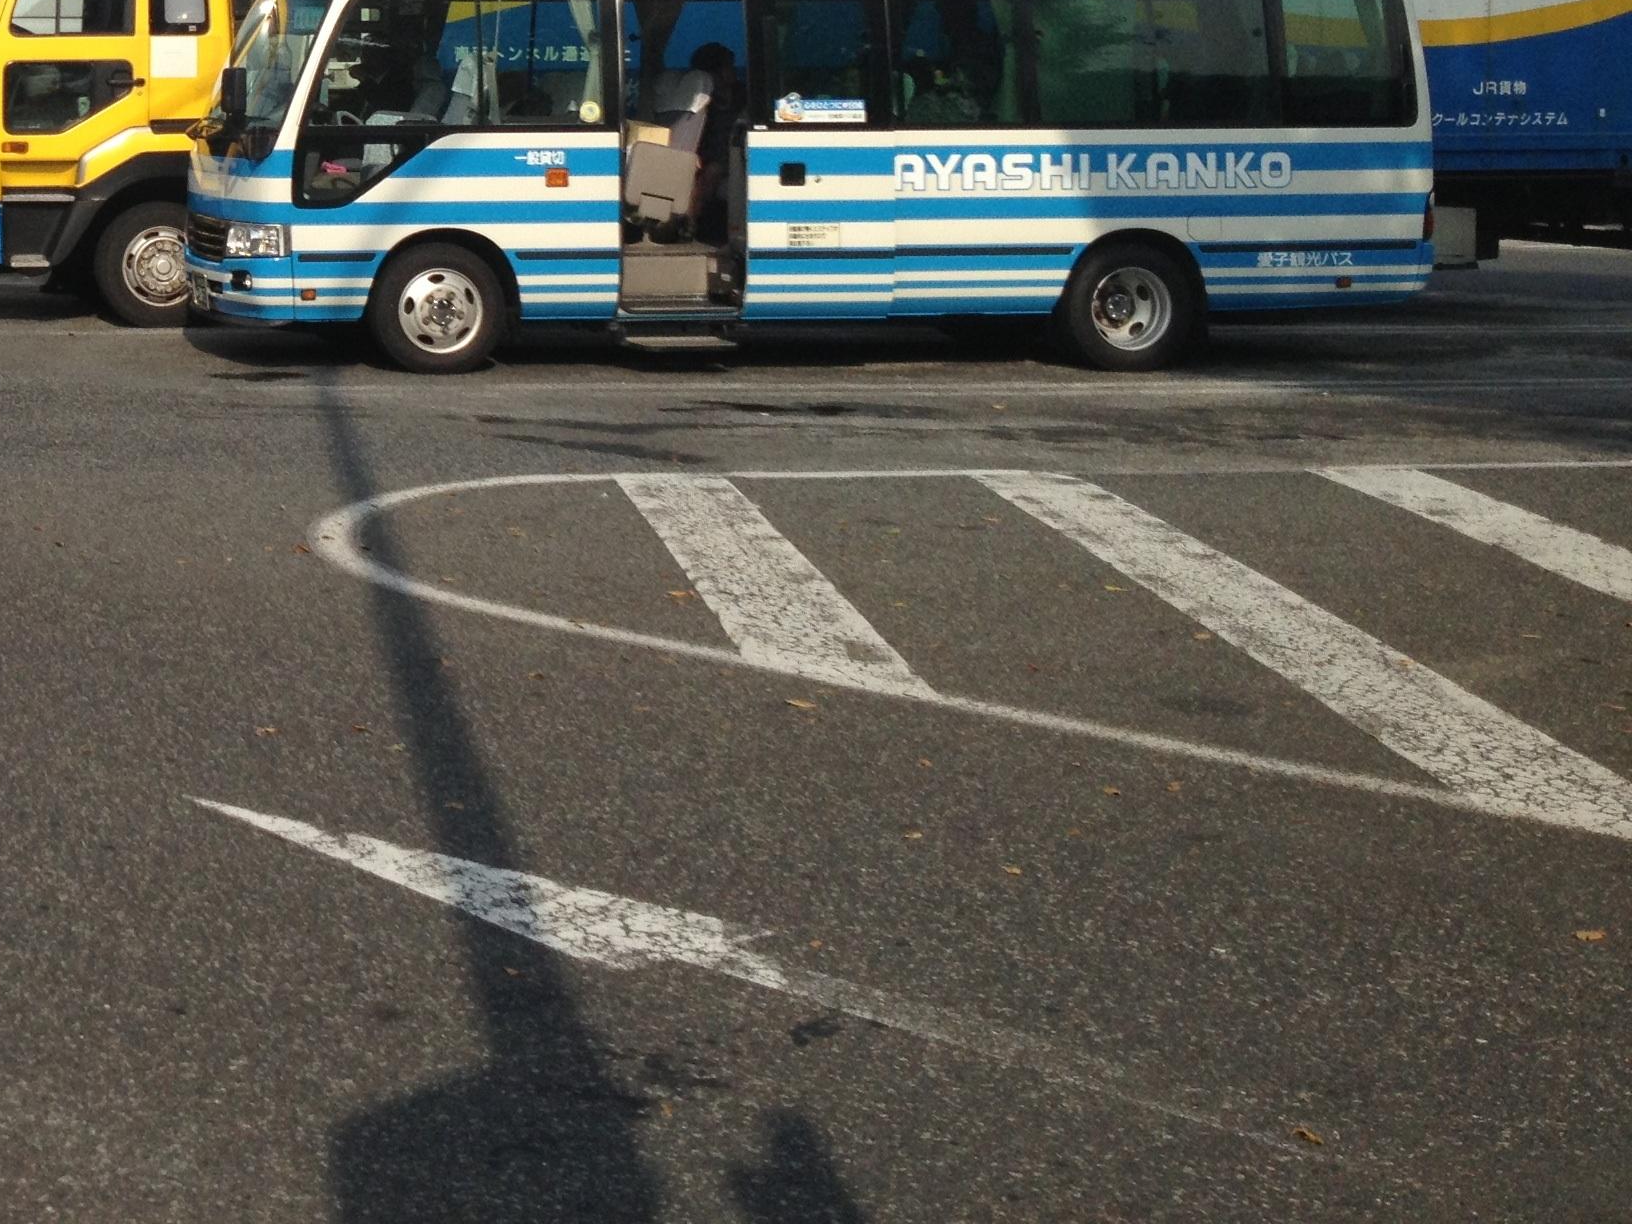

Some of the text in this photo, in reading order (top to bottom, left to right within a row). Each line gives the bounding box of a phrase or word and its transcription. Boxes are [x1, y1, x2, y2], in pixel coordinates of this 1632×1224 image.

[1472, 81, 1527, 95] JR貨物
[893, 151, 1292, 191] AYASHI KANKO
